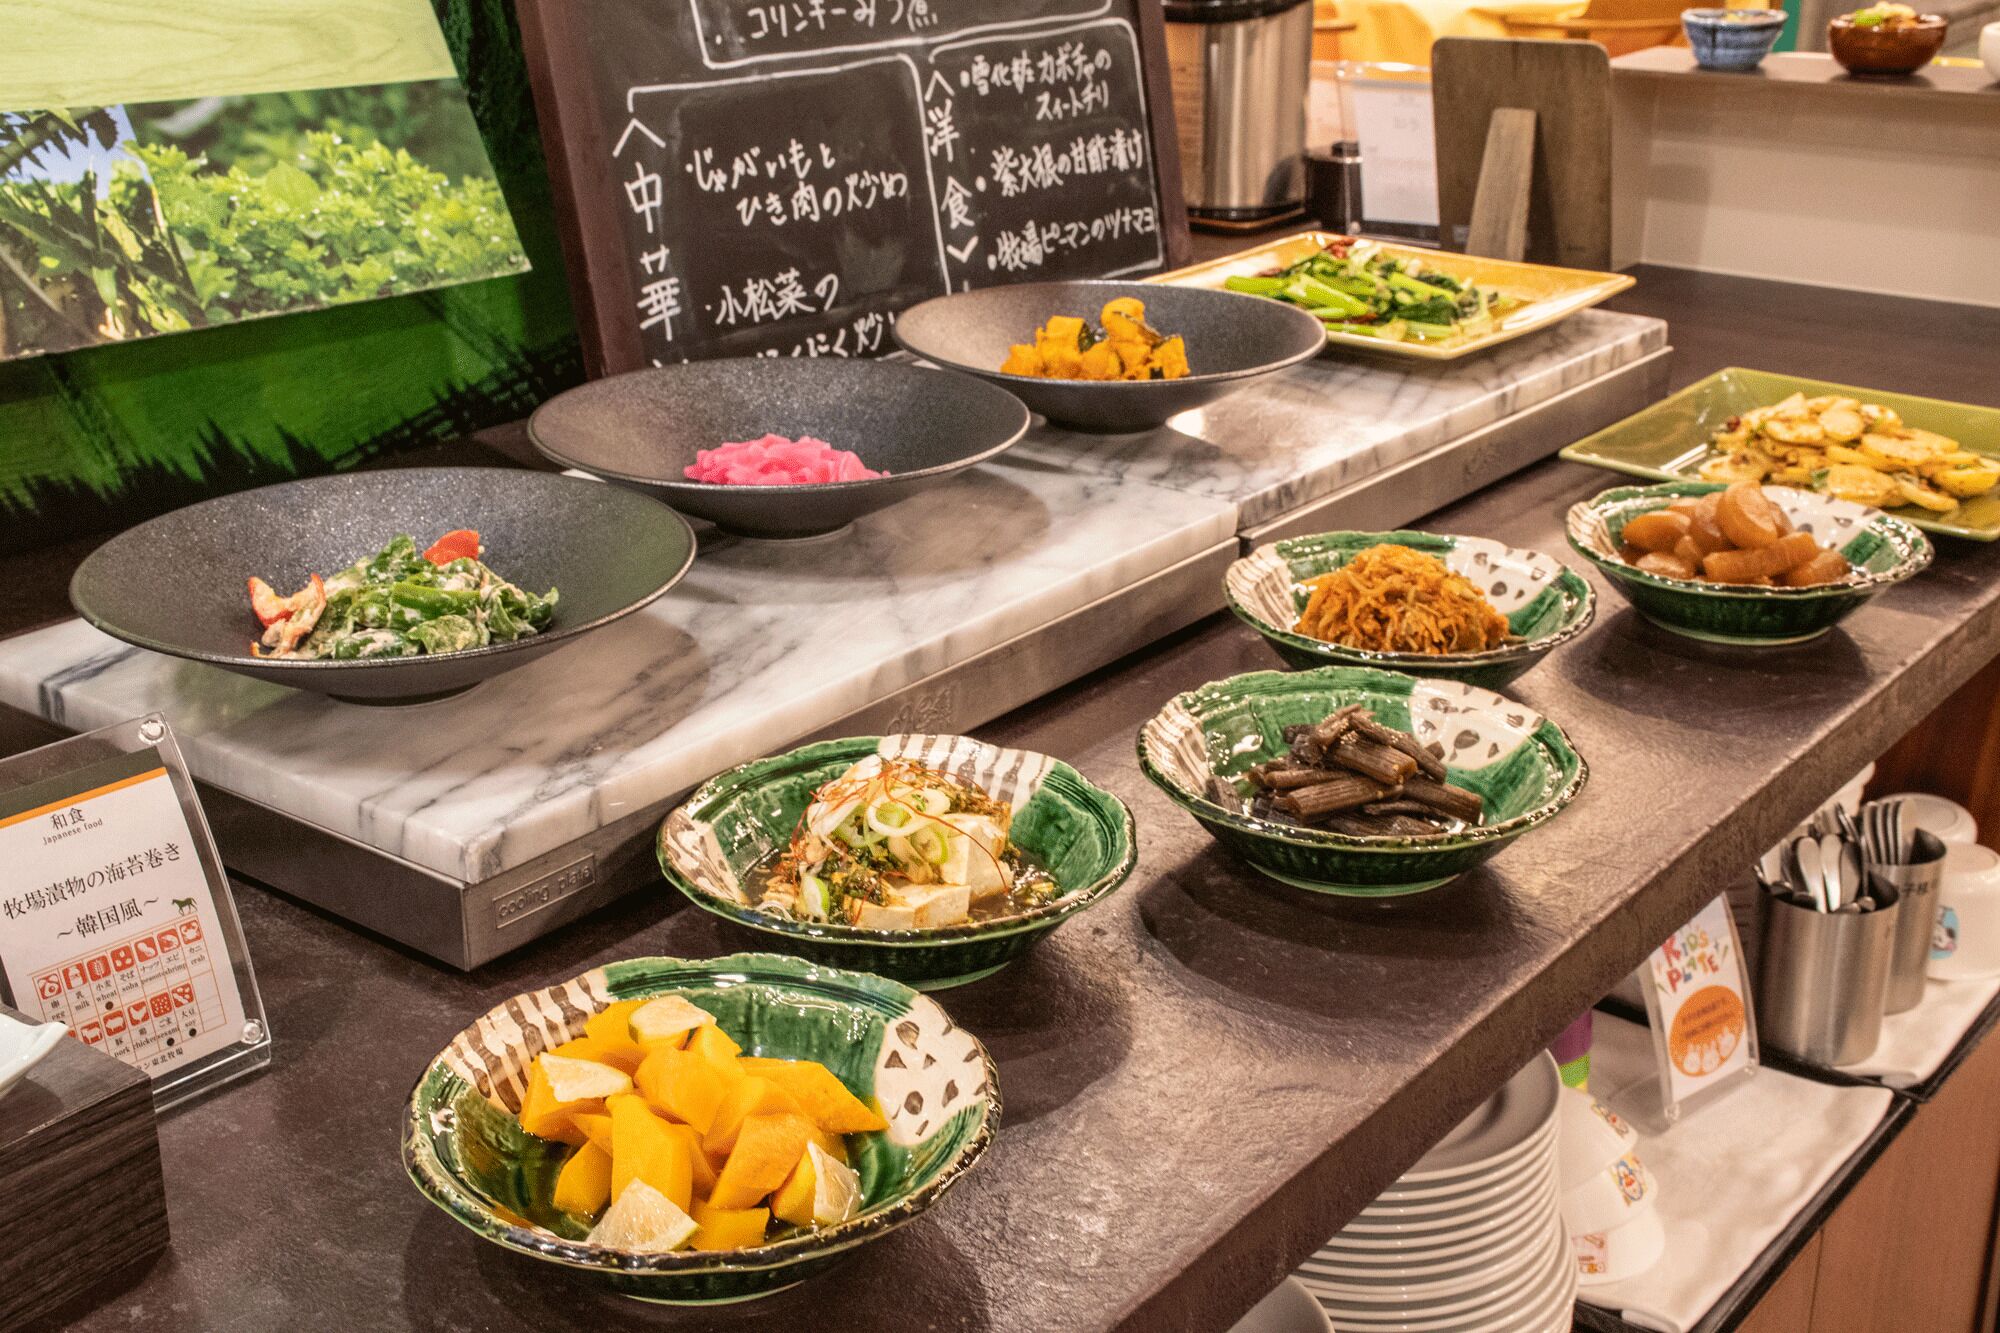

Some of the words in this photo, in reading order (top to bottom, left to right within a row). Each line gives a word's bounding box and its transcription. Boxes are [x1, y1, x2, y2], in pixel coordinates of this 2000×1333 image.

[693, 138, 835, 192] じゃがいもと
[736, 170, 908, 226] ひき肉の炒め
[995, 207, 1156, 272] 牧場ピーマンのツナマヨ
[715, 267, 839, 325] 小松菜の
[43, 826, 82, 846] Japanese
[84, 818, 104, 831] food
[51, 807, 86, 831] 和食
[3, 842, 181, 920] 牧場漬物の海苔巻き
[1662, 929, 1709, 968] KIDS
[1667, 952, 1719, 993] PLATE
[75, 1001, 90, 1012] milk
[96, 989, 117, 1002] wheat
[121, 982, 140, 993] soba
